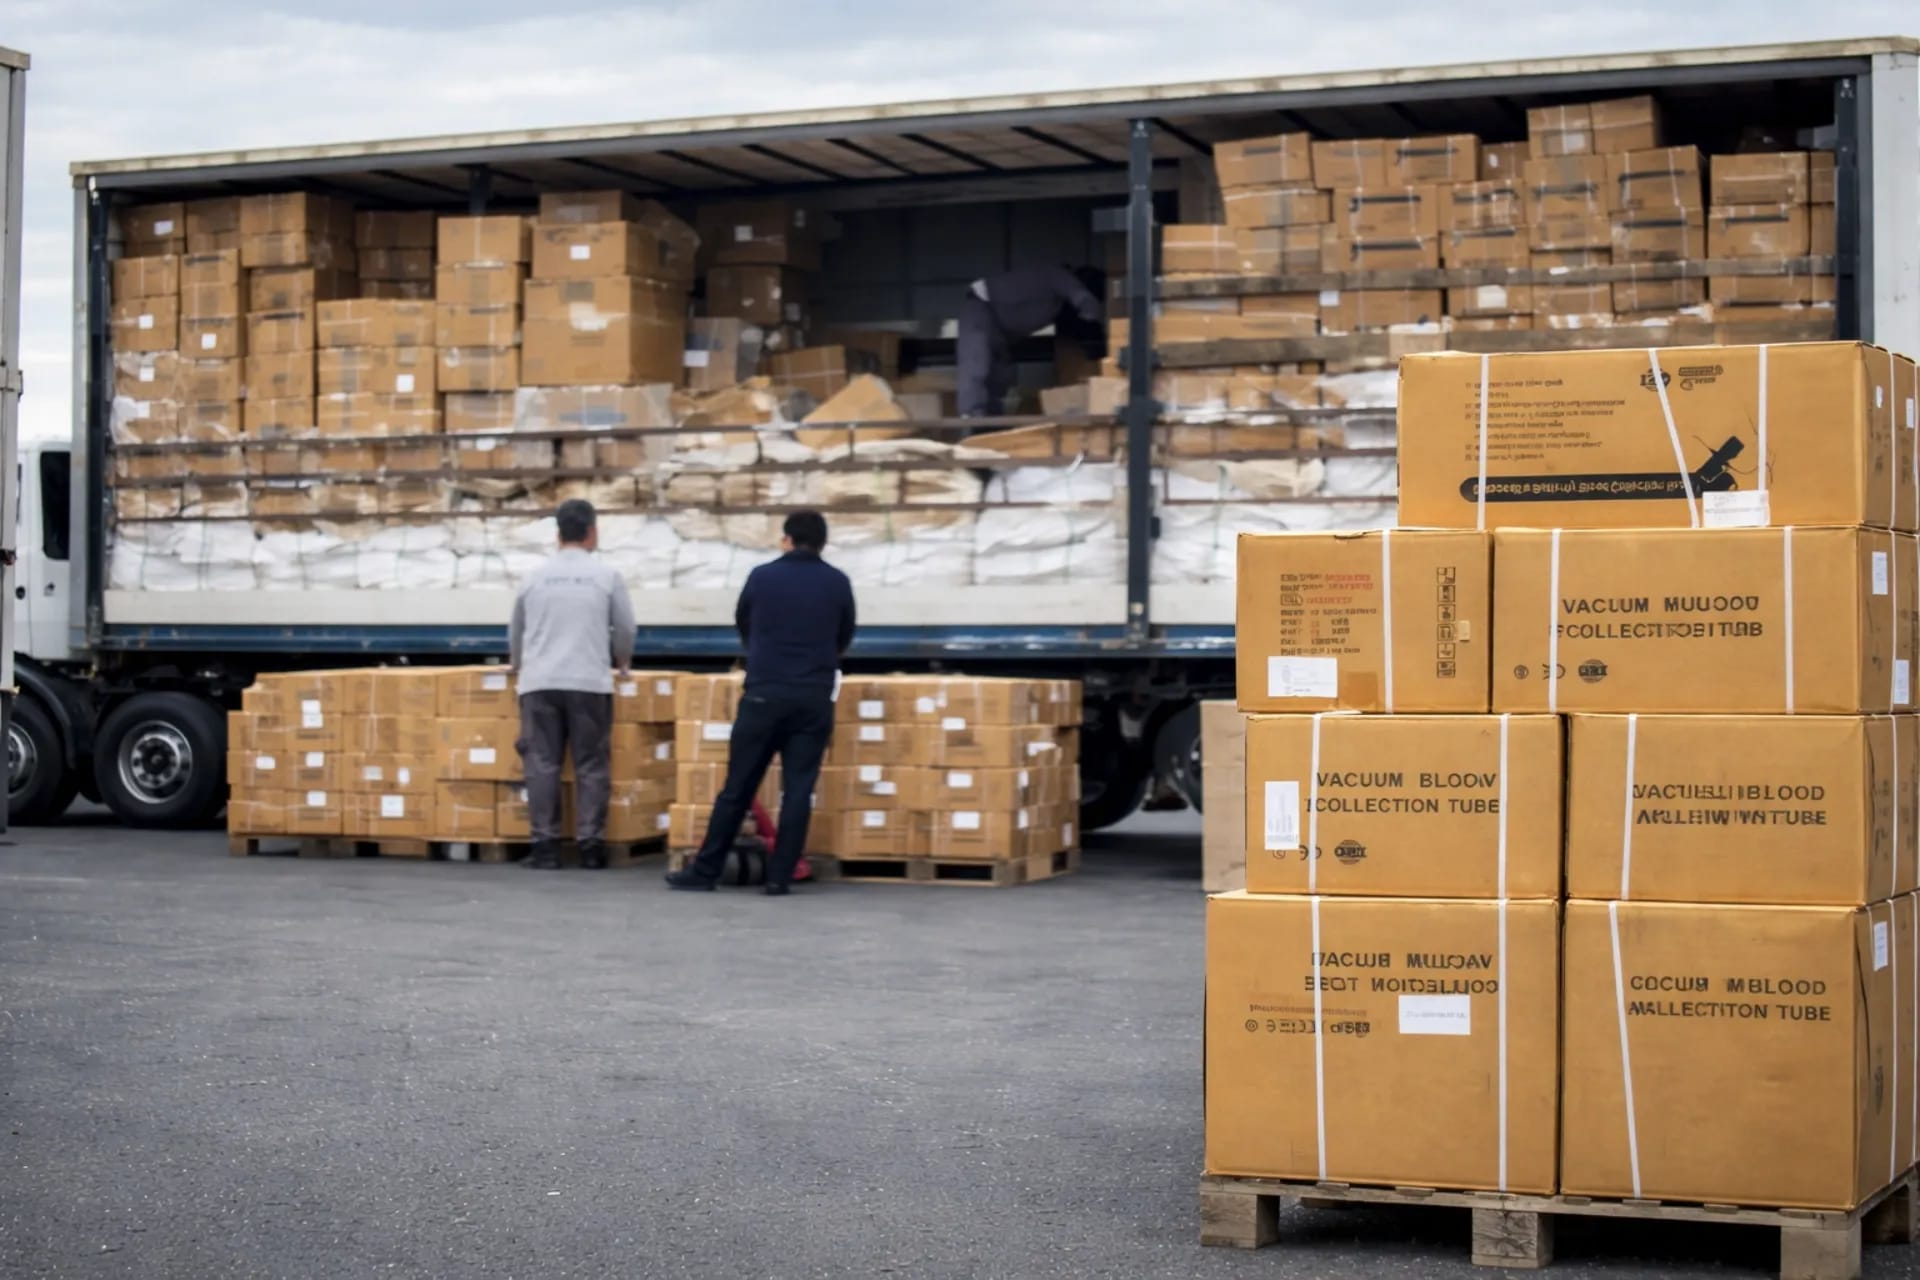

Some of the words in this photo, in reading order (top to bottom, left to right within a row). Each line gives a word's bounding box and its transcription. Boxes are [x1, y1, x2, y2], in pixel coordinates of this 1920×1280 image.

[1316, 772, 1404, 788] VACUUM
[1449, 798, 1500, 814] TUBE
[1776, 1005, 1832, 1021] TUBE
